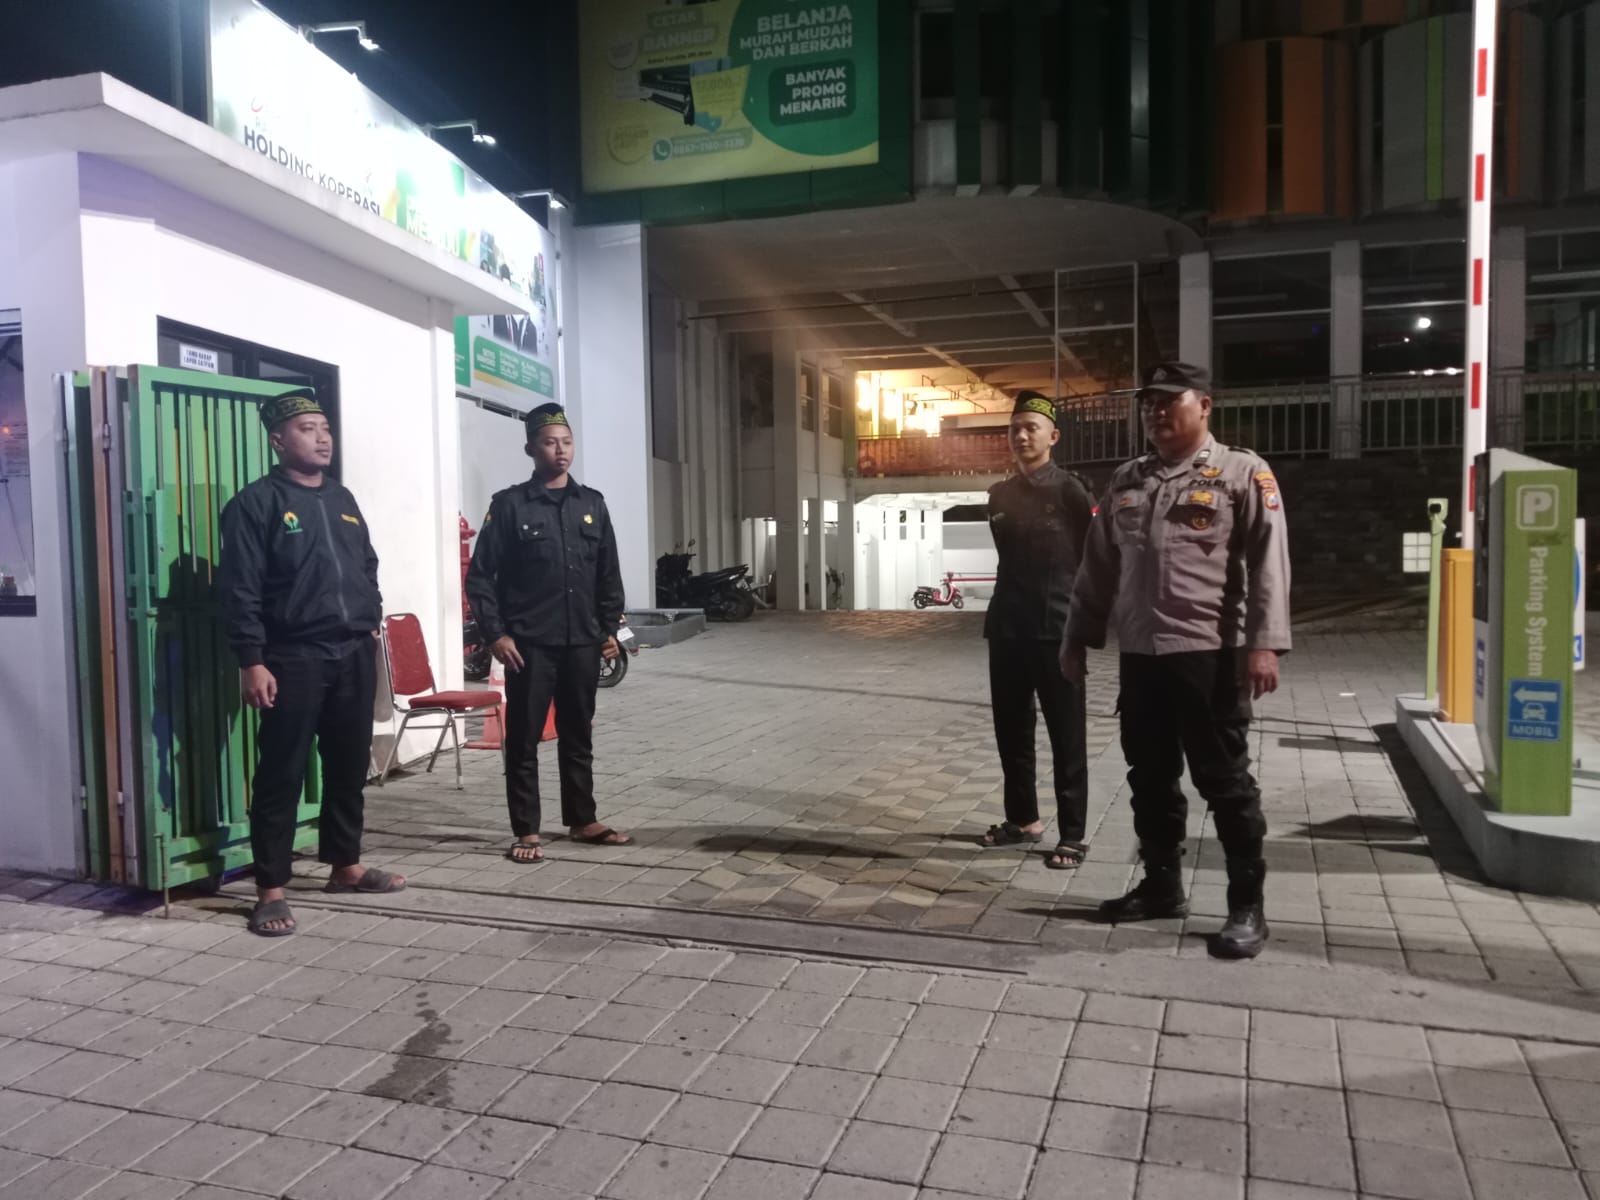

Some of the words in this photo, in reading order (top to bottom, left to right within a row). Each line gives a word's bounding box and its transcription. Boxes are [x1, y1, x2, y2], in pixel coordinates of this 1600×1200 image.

[757, 5, 852, 32] BELANJA
[739, 31, 792, 49] MURAH
[796, 23, 853, 41] MUDAH
[752, 44, 785, 60] DAN
[789, 35, 853, 55] BERKAH
[785, 66, 847, 86] BANYAK
[791, 82, 847, 100] PROMO
[779, 95, 847, 116] MENARIK
[244, 125, 315, 182] HOLDING
[1189, 479, 1227, 489] POLRI
[1523, 490, 1553, 525] P
[1525, 546, 1548, 614] Parking
[1525, 616, 1548, 677] System
[1511, 724, 1555, 737] MOBIL
